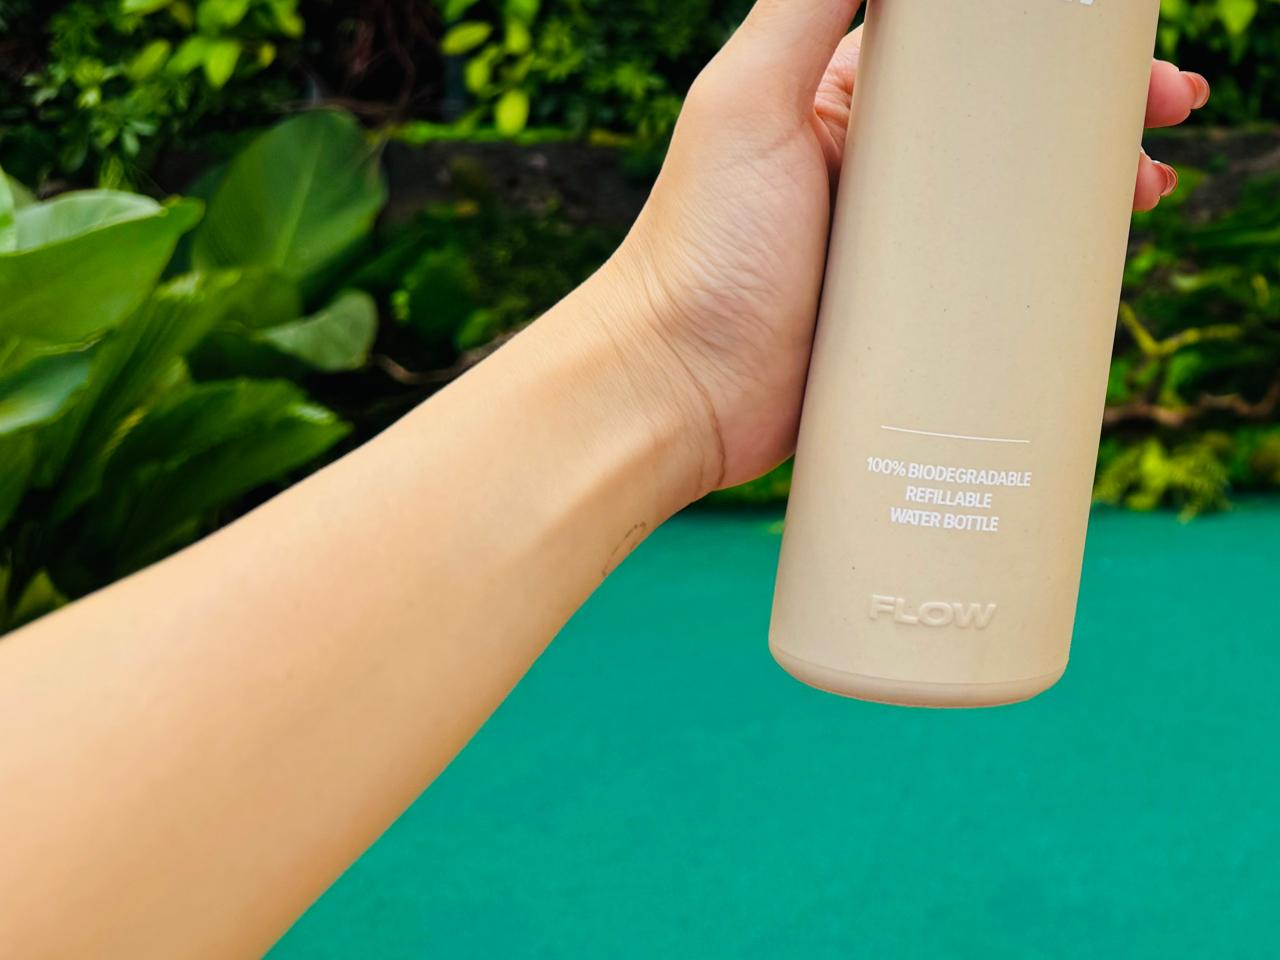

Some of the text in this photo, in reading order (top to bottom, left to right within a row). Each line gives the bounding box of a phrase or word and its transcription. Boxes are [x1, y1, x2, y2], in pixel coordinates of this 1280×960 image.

[866, 456, 1032, 487] 100% BIODEGRADABLE
[905, 486, 993, 508] REFILLABLE
[890, 506, 999, 532] WATER BOTTLE
[868, 593, 998, 631] FLOW
